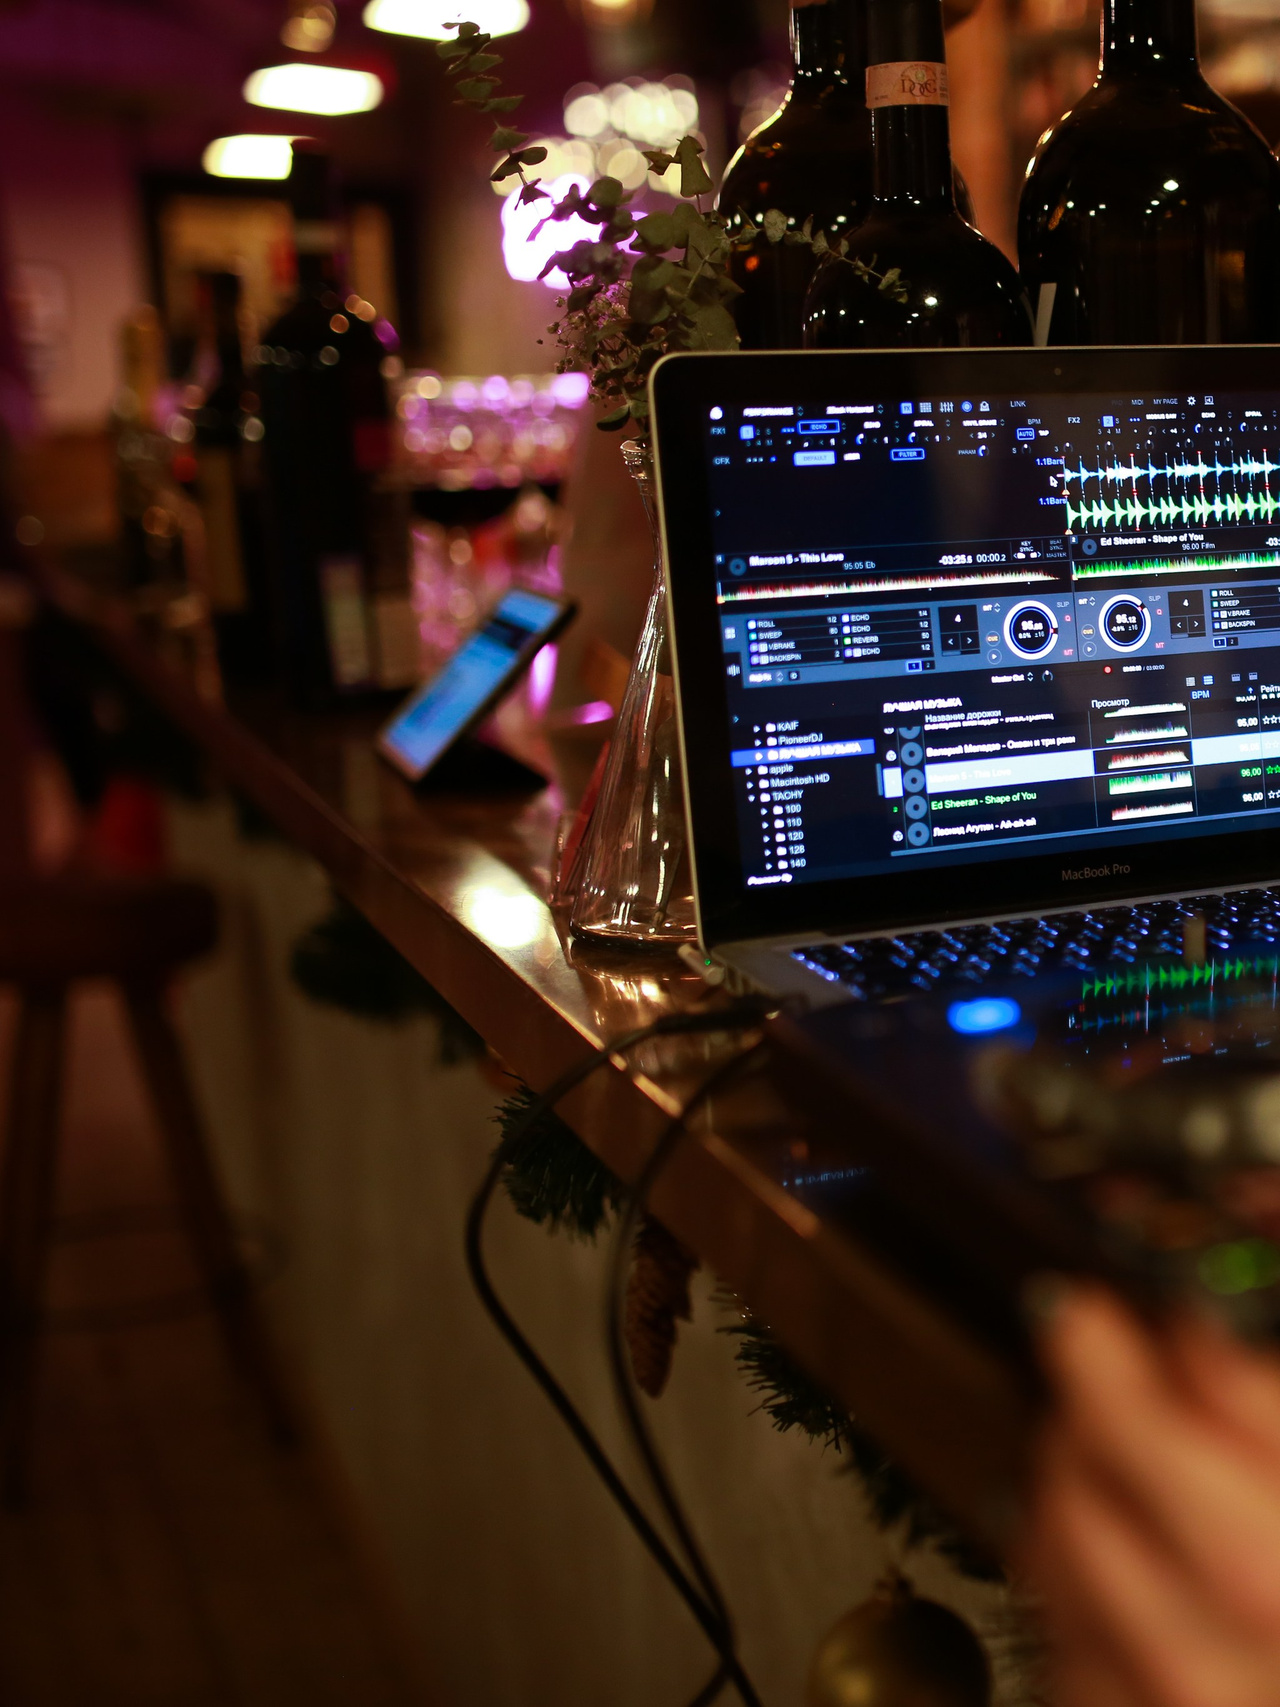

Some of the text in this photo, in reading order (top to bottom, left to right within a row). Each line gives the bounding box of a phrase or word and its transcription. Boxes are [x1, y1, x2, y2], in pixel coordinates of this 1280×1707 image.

[711, 427, 726, 435] FX1
[713, 456, 730, 465] CFX
[1101, 537, 1112, 546] Ed
[1113, 536, 1146, 546] Sheeran
[1153, 535, 1177, 545] Shape
[749, 555, 785, 566] Maroon
[800, 553, 820, 563] This
[821, 552, 844, 562] Love
[844, 562, 864, 570] 95.05
[1192, 690, 1210, 699] BPM
[1091, 699, 1130, 709] Просмотр
[925, 712, 965, 723] Название
[777, 721, 799, 732] KAIF
[778, 733, 823, 745] PioneerDJ
[769, 764, 794, 775] apple
[1241, 767, 1262, 777] 96,00
[770, 773, 830, 788] Macintosh HD
[772, 790, 804, 801] TACHY
[931, 792, 1036, 810] Ed Sheeran Shape of You
[1242, 792, 1263, 803] 96,00
[785, 803, 802, 814] 100
[786, 817, 802, 828] 110
[787, 831, 804, 841] 120
[788, 845, 806, 855] 128
[790, 858, 806, 868] 140
[1062, 864, 1130, 881] MacBook Pro
